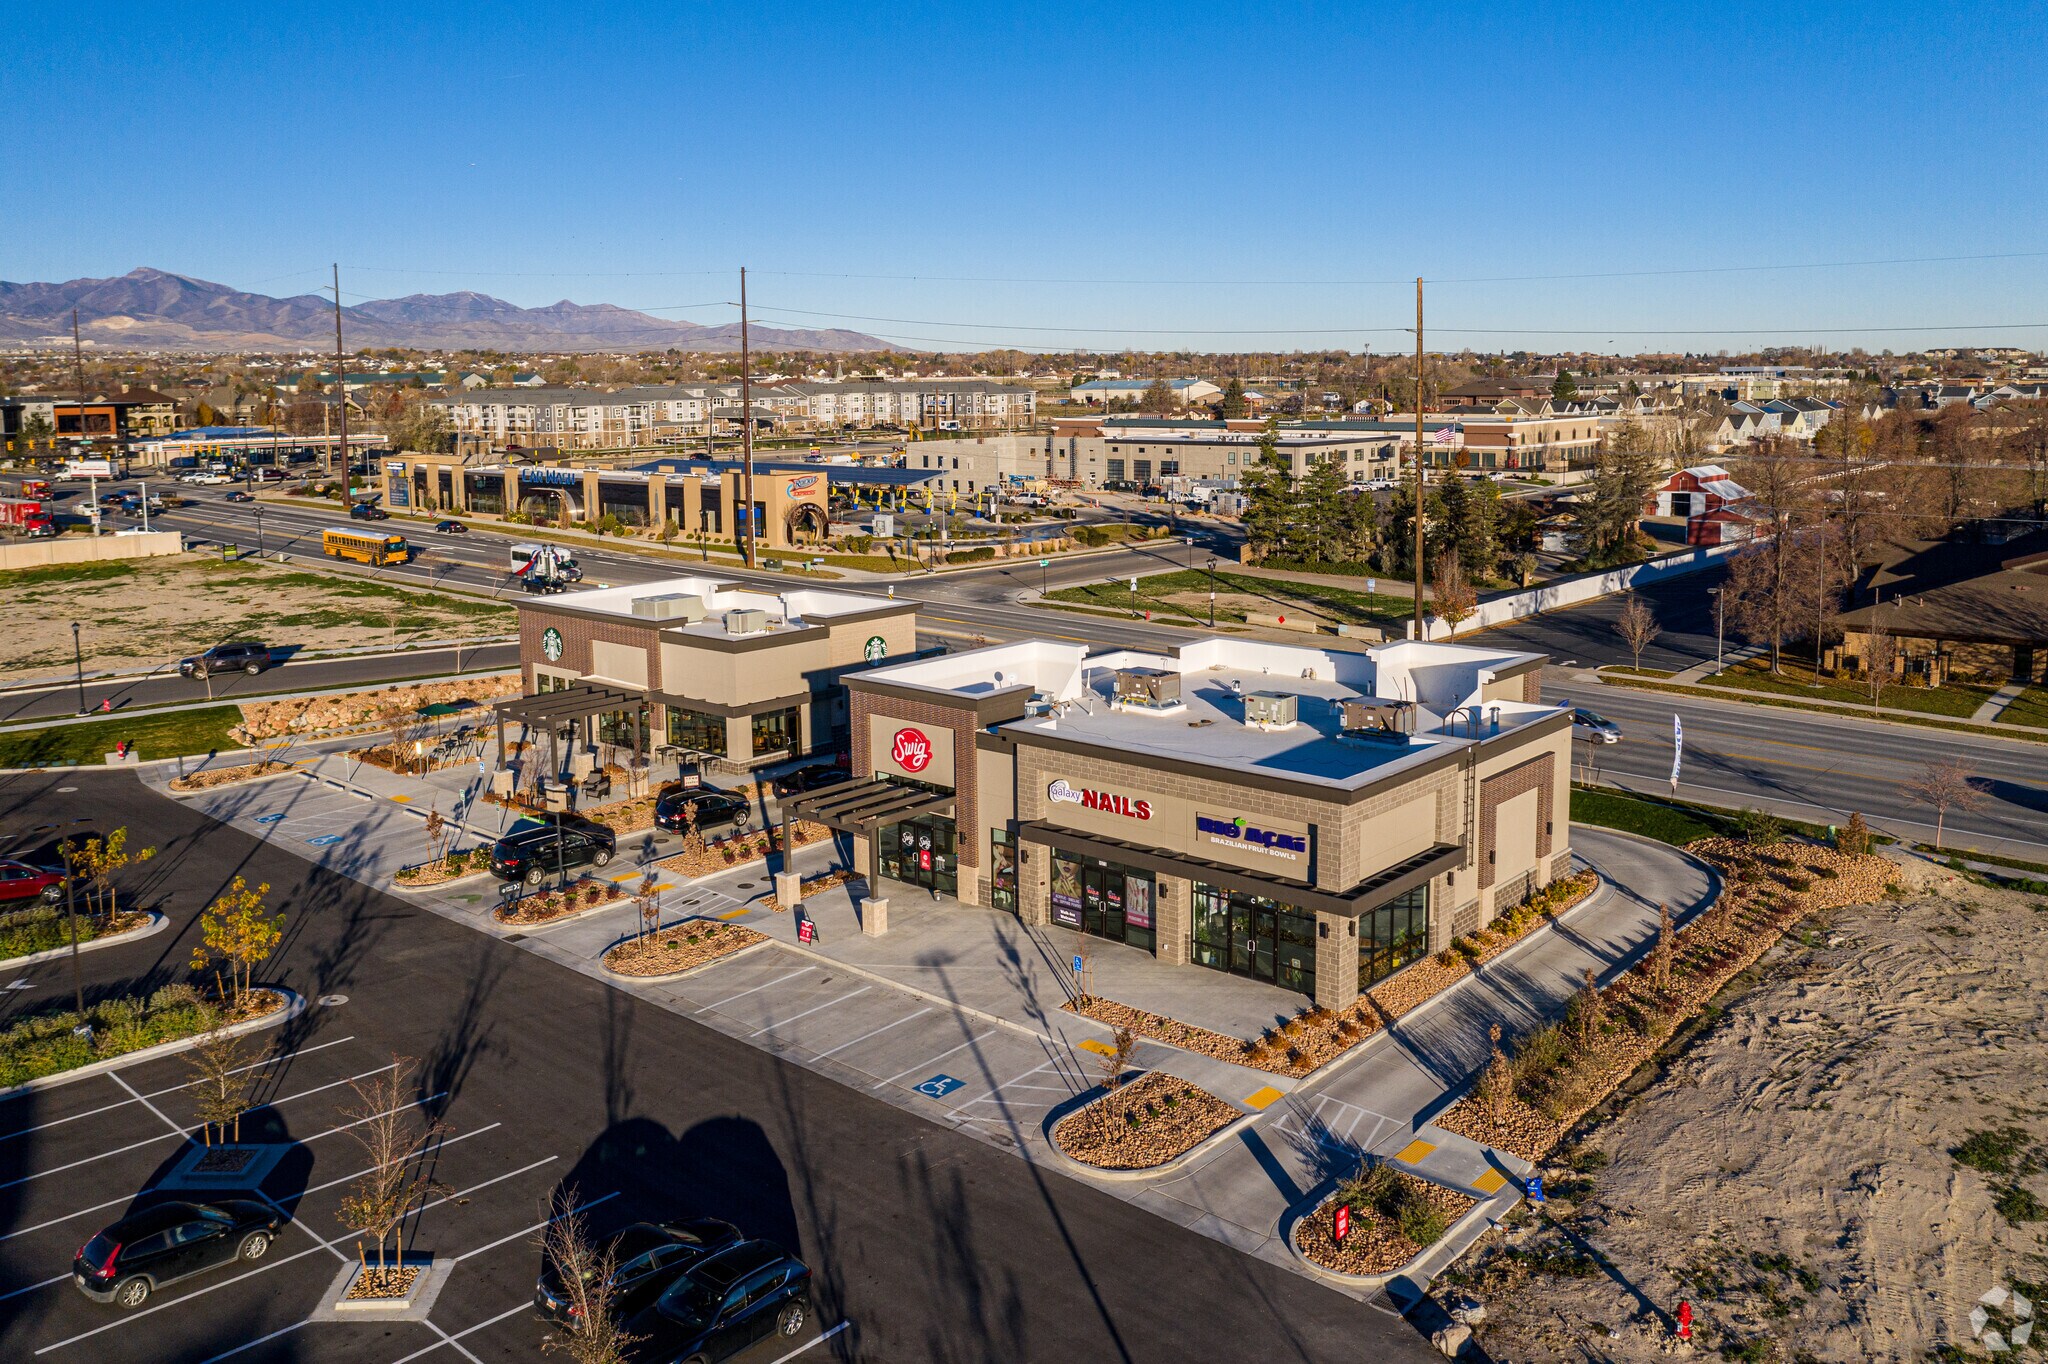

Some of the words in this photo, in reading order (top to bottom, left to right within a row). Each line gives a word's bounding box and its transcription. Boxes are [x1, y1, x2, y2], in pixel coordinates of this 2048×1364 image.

[522, 468, 543, 483] CAR
[546, 470, 576, 486] WASH
[894, 734, 928, 767] Swig
[1050, 784, 1080, 802] Galaxy
[1082, 788, 1153, 821] NAILS
[1197, 816, 1241, 839] RIO
[1210, 836, 1248, 851] BRAZILIAN
[1248, 844, 1269, 855] FRUIT
[1269, 849, 1297, 861] BOWLS
